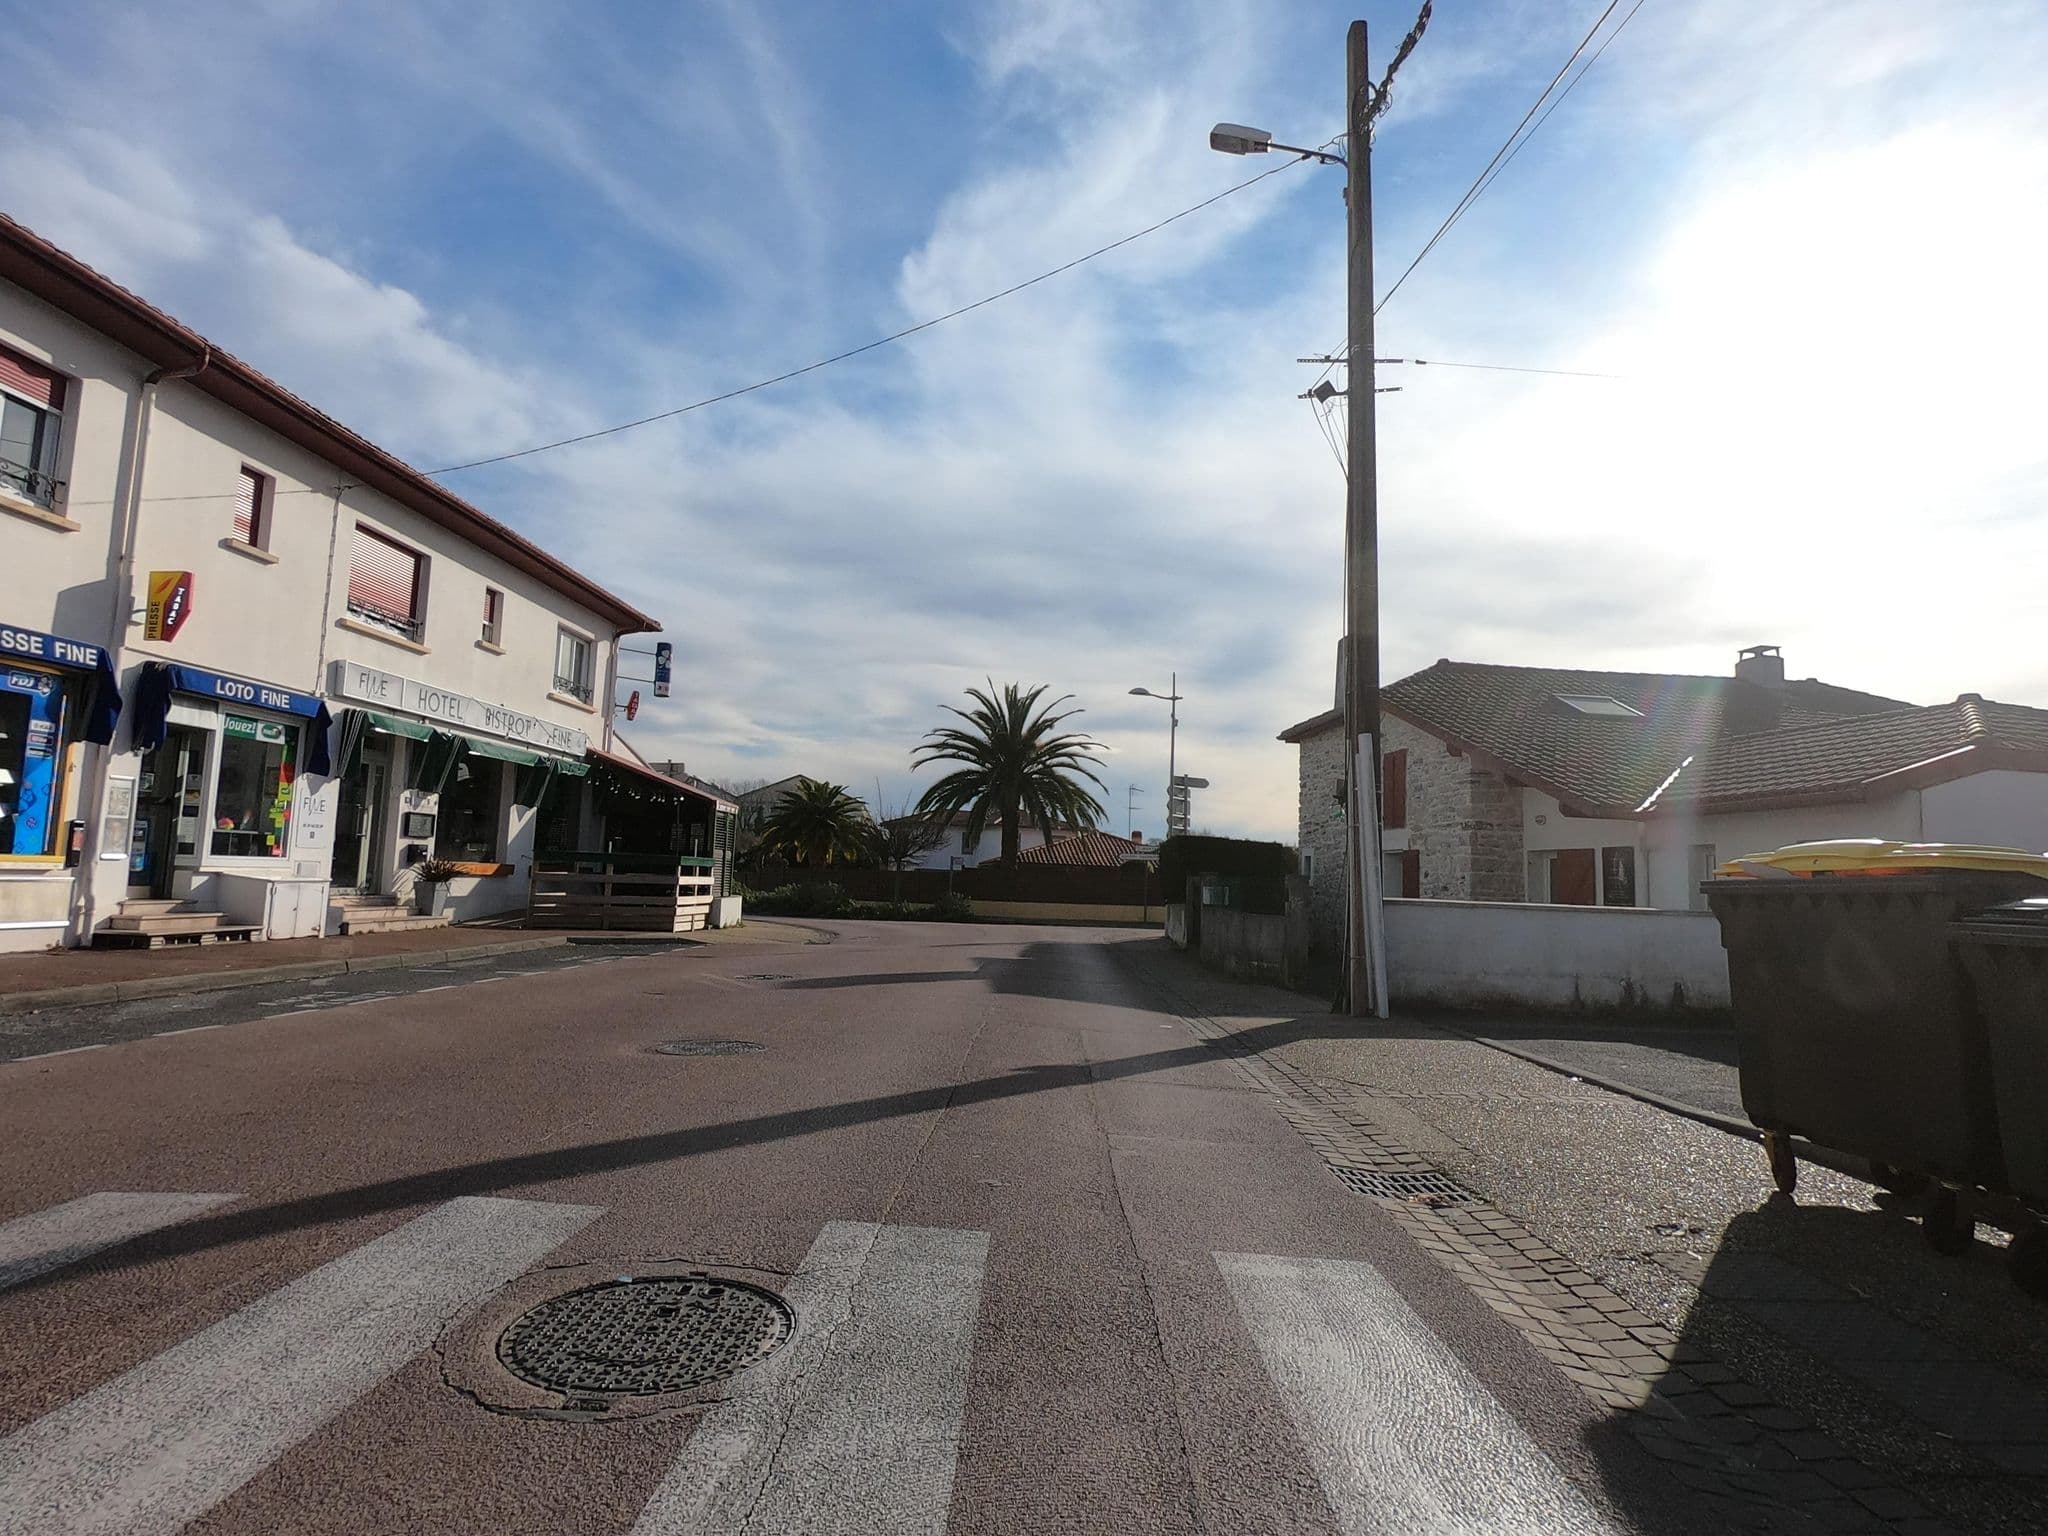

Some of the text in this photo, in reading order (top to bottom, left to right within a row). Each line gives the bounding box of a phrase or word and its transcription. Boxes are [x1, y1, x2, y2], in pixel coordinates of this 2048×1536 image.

[147, 600, 161, 639] PRESSE
[167, 587, 185, 625] TABAC
[0, 629, 98, 667] SSE FINE
[216, 679, 290, 709] LOTO FINE
[223, 717, 257, 734] Jouez!
[418, 688, 572, 748] HOTEL BISTROT FINE
